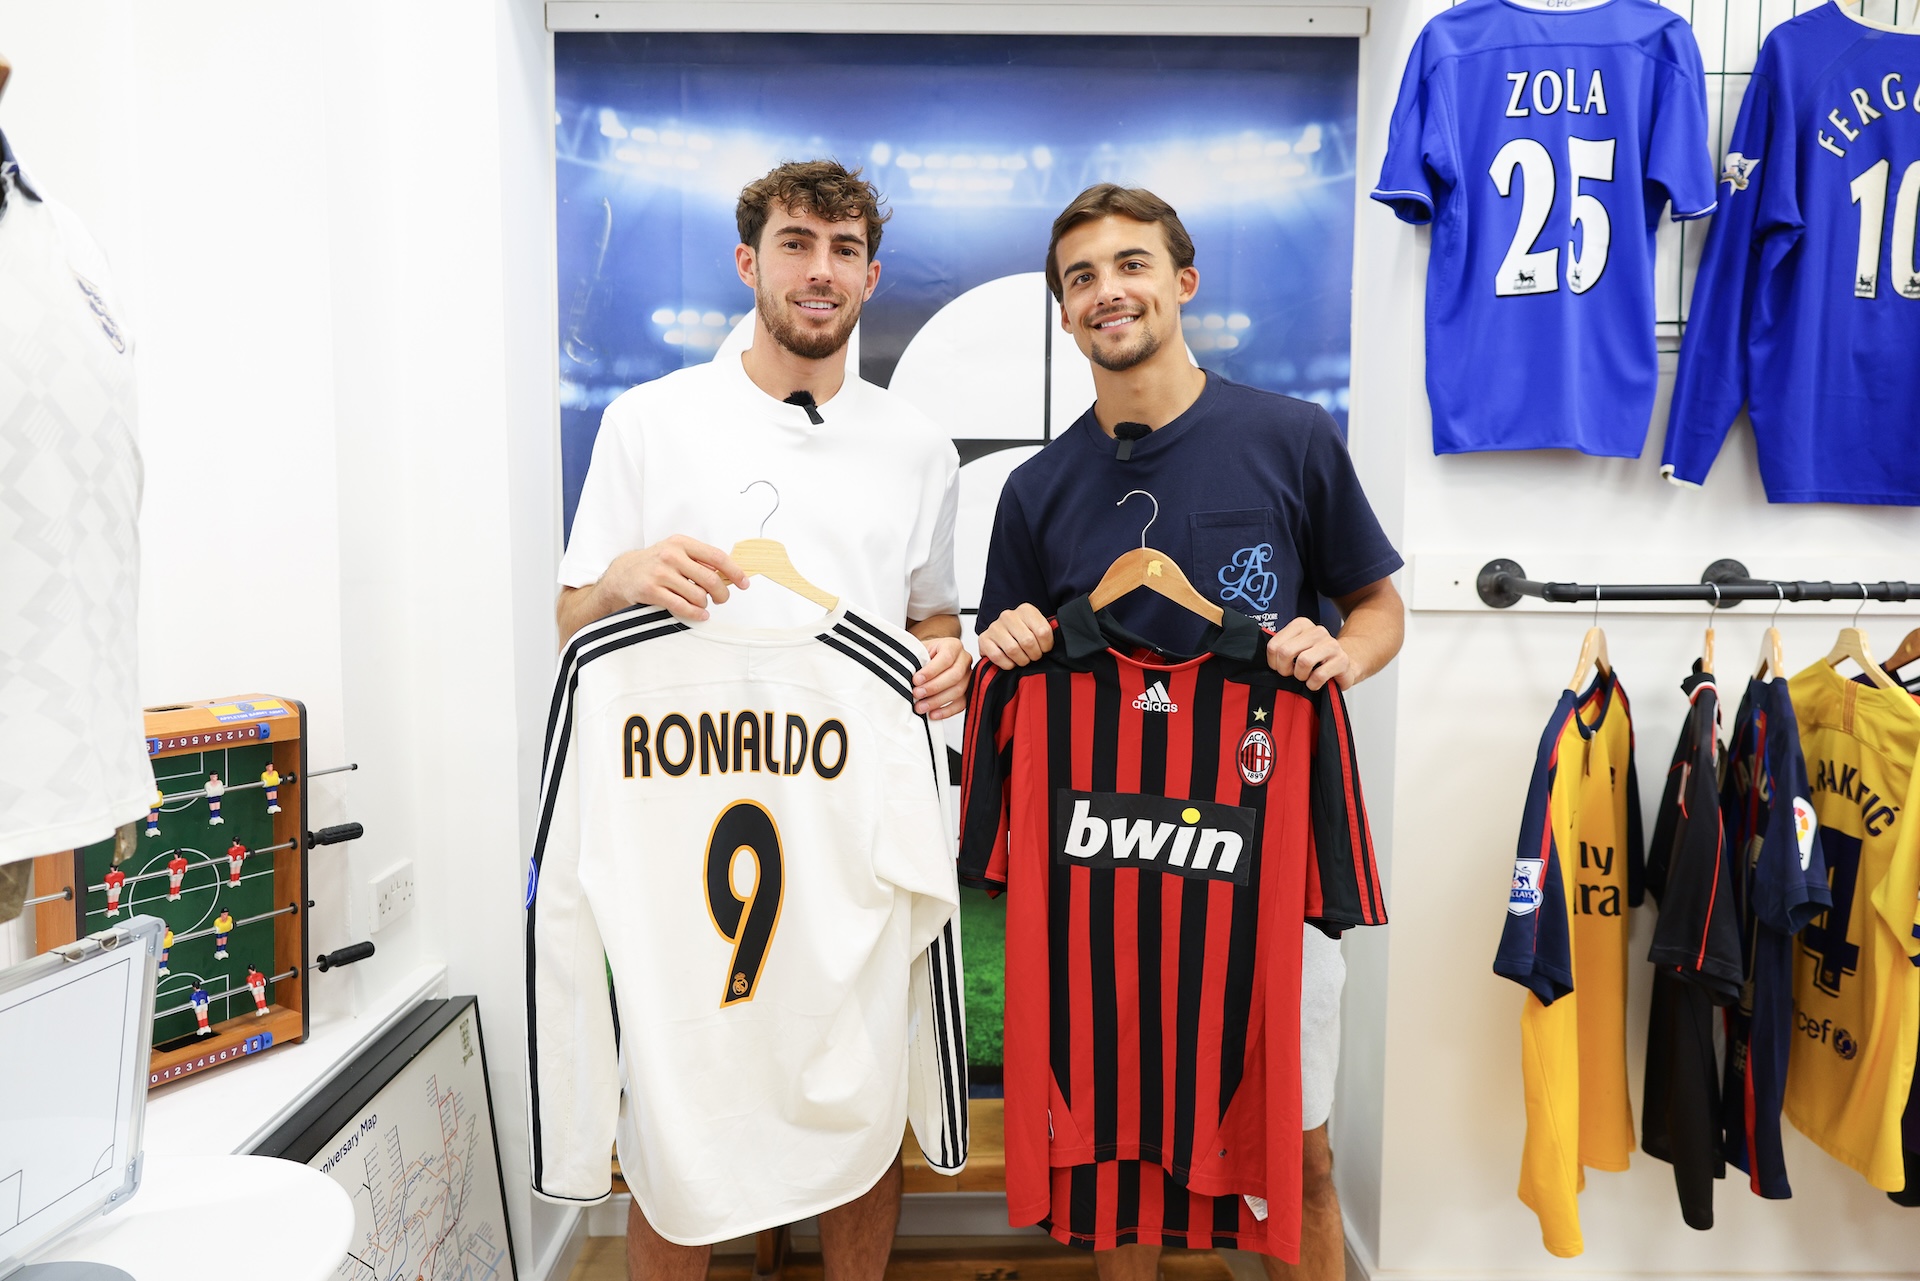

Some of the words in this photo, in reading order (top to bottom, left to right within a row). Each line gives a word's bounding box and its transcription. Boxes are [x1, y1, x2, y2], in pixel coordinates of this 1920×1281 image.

[1505, 68, 1608, 118] ZOLA
[1489, 135, 1616, 297] 25
[1131, 699, 1178, 713] adidas
[622, 709, 849, 781] RONALDO
[1246, 733, 1268, 745] ACM
[1247, 771, 1264, 780] 1899
[1063, 799, 1244, 874] bwin
[1579, 841, 1614, 876] ly
[702, 798, 785, 1009] 9
[1798, 825, 1863, 998] 4
[1797, 1010, 1832, 1044] cef
[360, 1114, 377, 1137] Map
